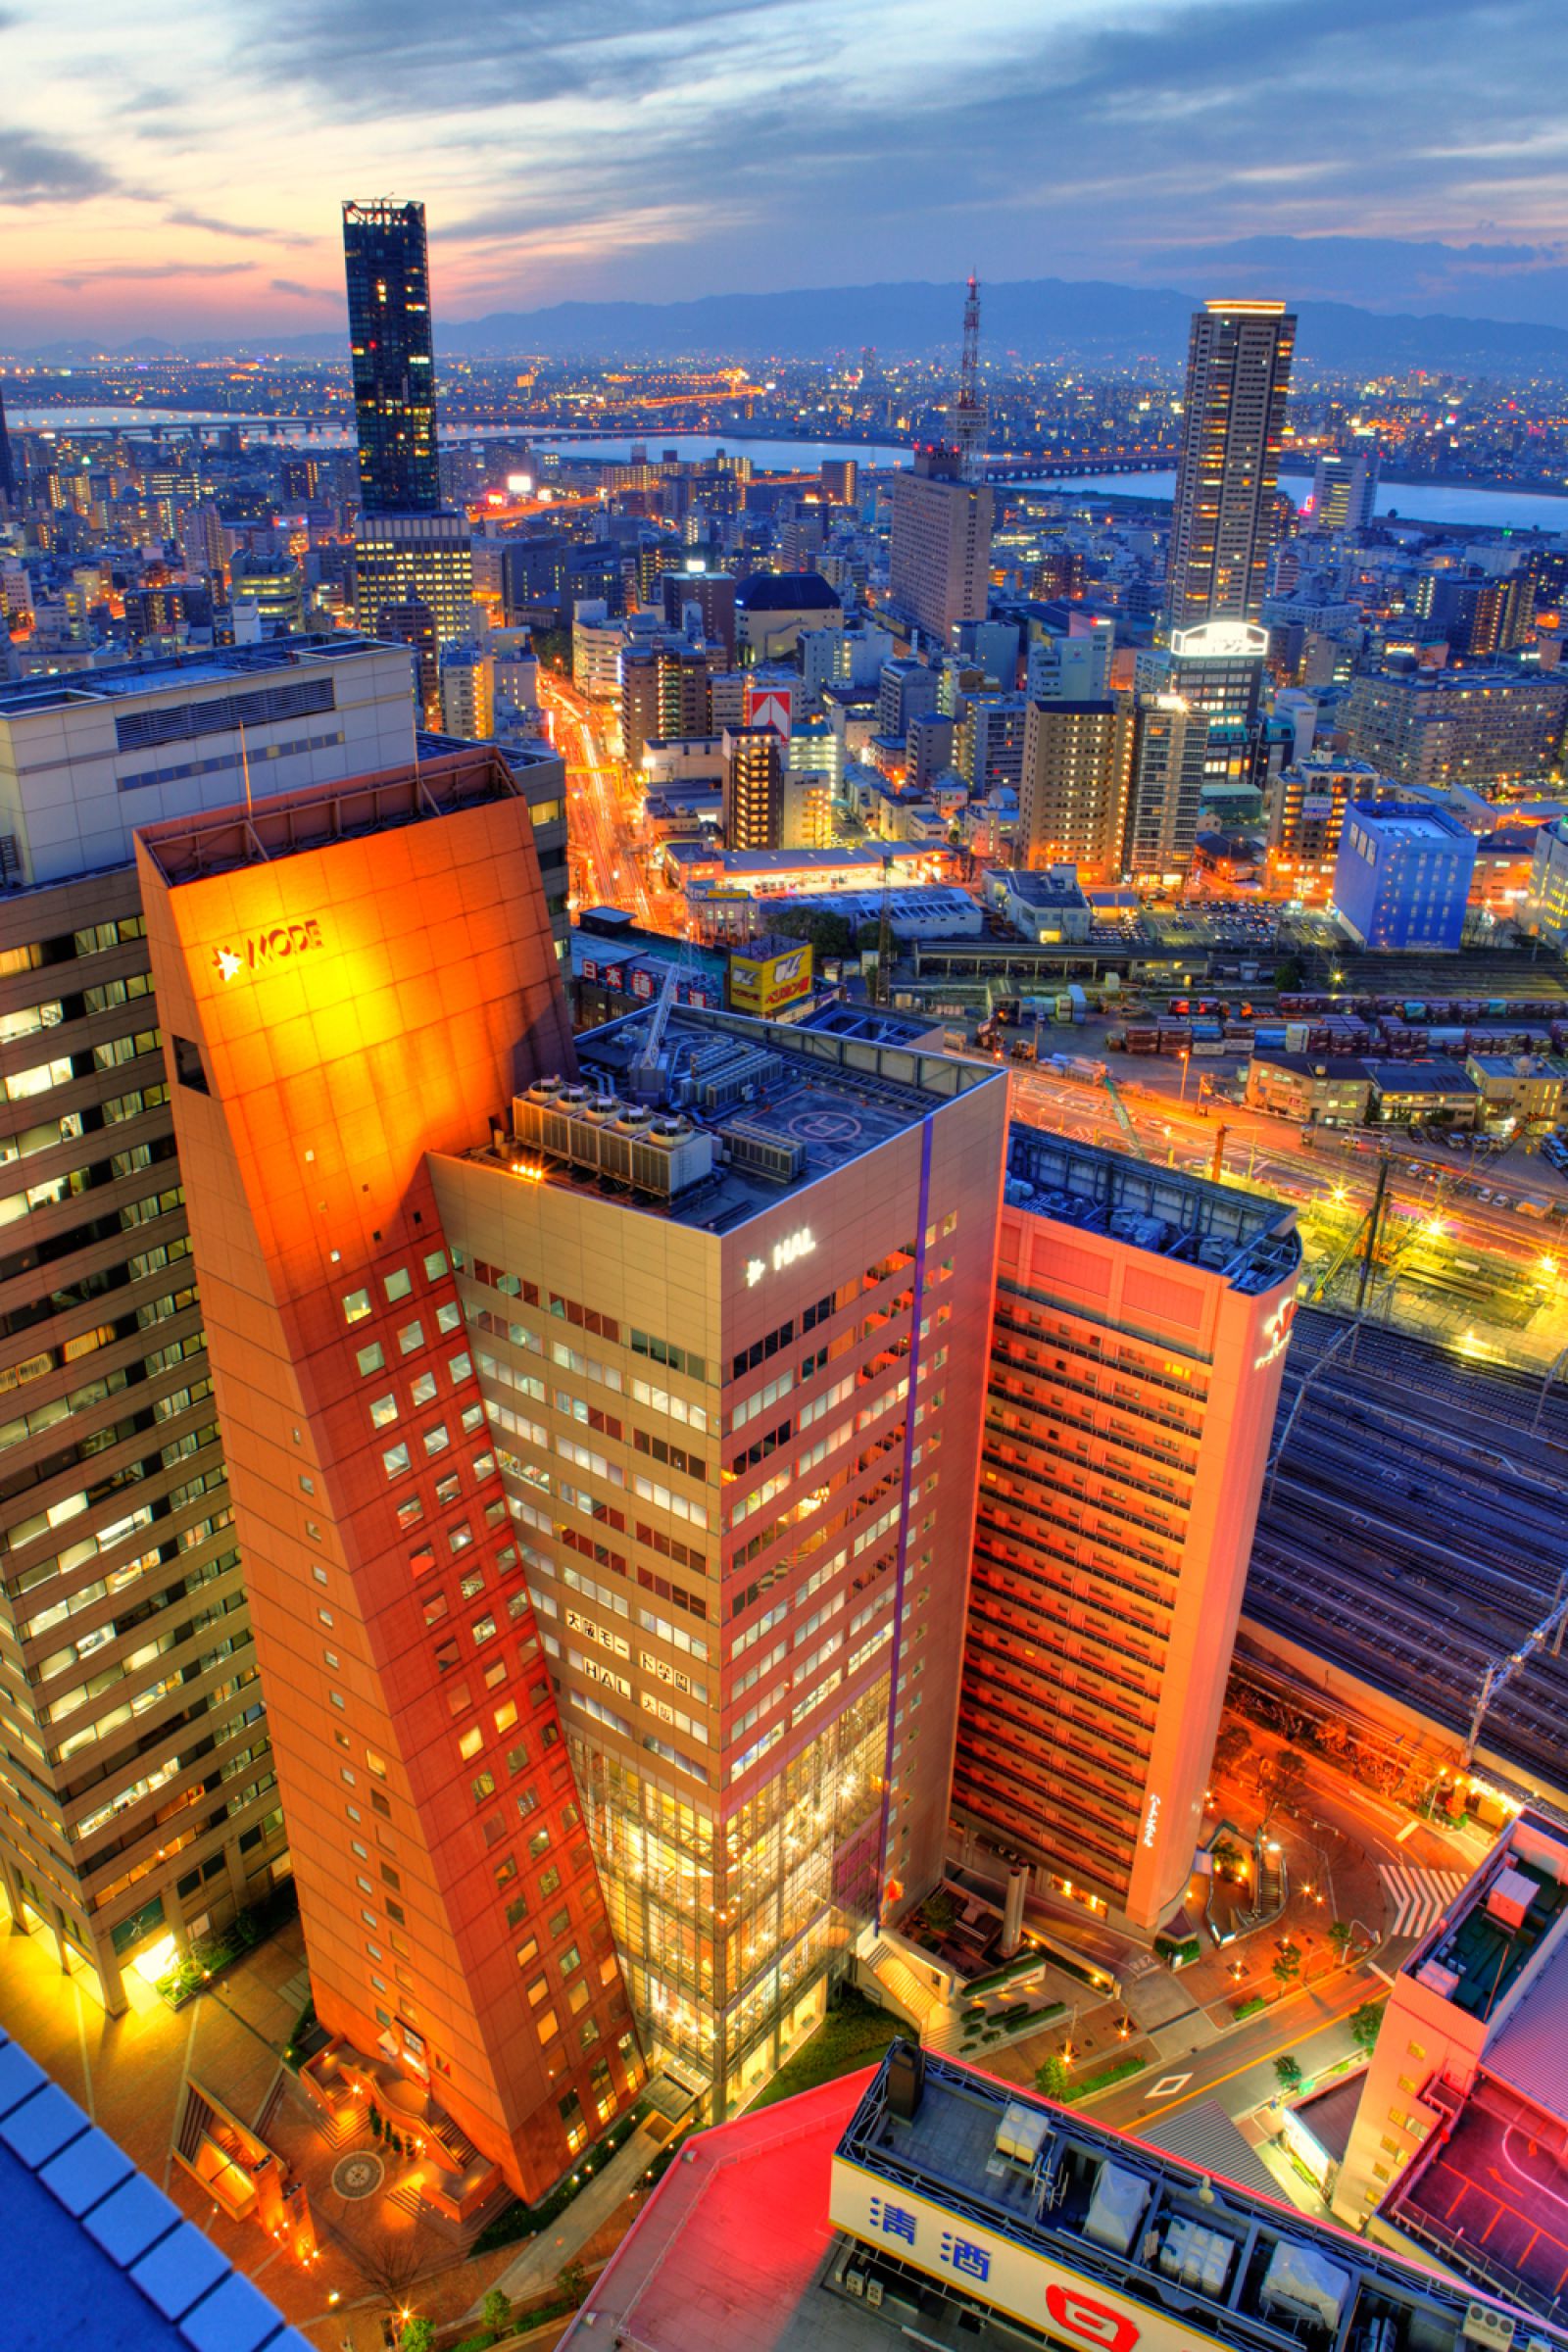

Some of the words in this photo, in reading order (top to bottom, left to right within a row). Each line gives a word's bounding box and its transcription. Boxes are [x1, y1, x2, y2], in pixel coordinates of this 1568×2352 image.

[247, 919, 322, 969] MODE
[773, 1227, 816, 1271] HAL
[586, 1660, 629, 1697] HAL
